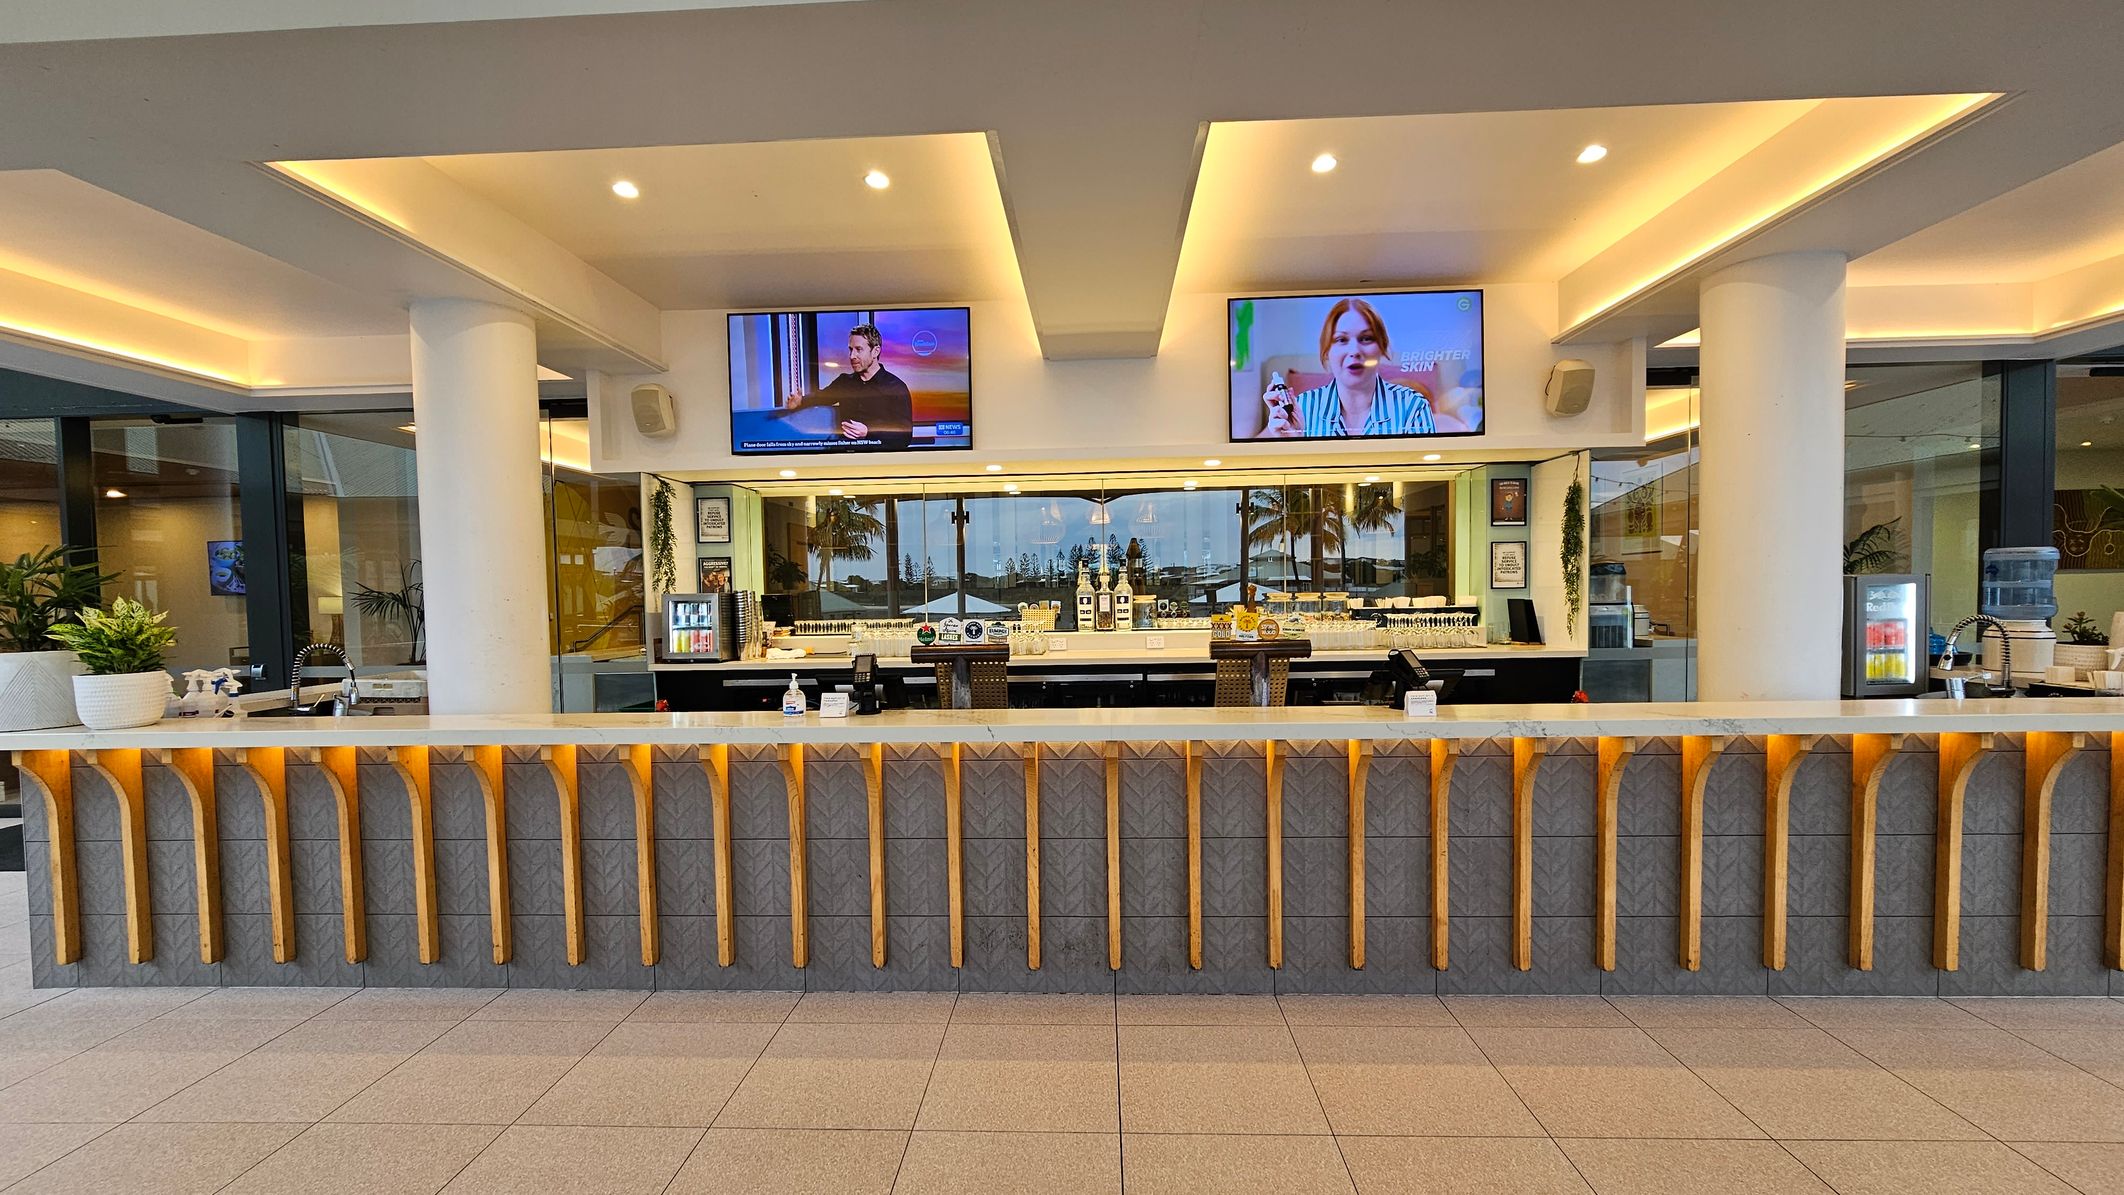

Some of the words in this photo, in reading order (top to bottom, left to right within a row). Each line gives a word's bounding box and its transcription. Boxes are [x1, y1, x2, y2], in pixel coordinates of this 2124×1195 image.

[1401, 350, 1471, 361] BRIGHTER
[1400, 361, 1435, 372] SKIN
[1211, 622, 1232, 630] XXXX
[1212, 630, 1231, 638] GOLD
